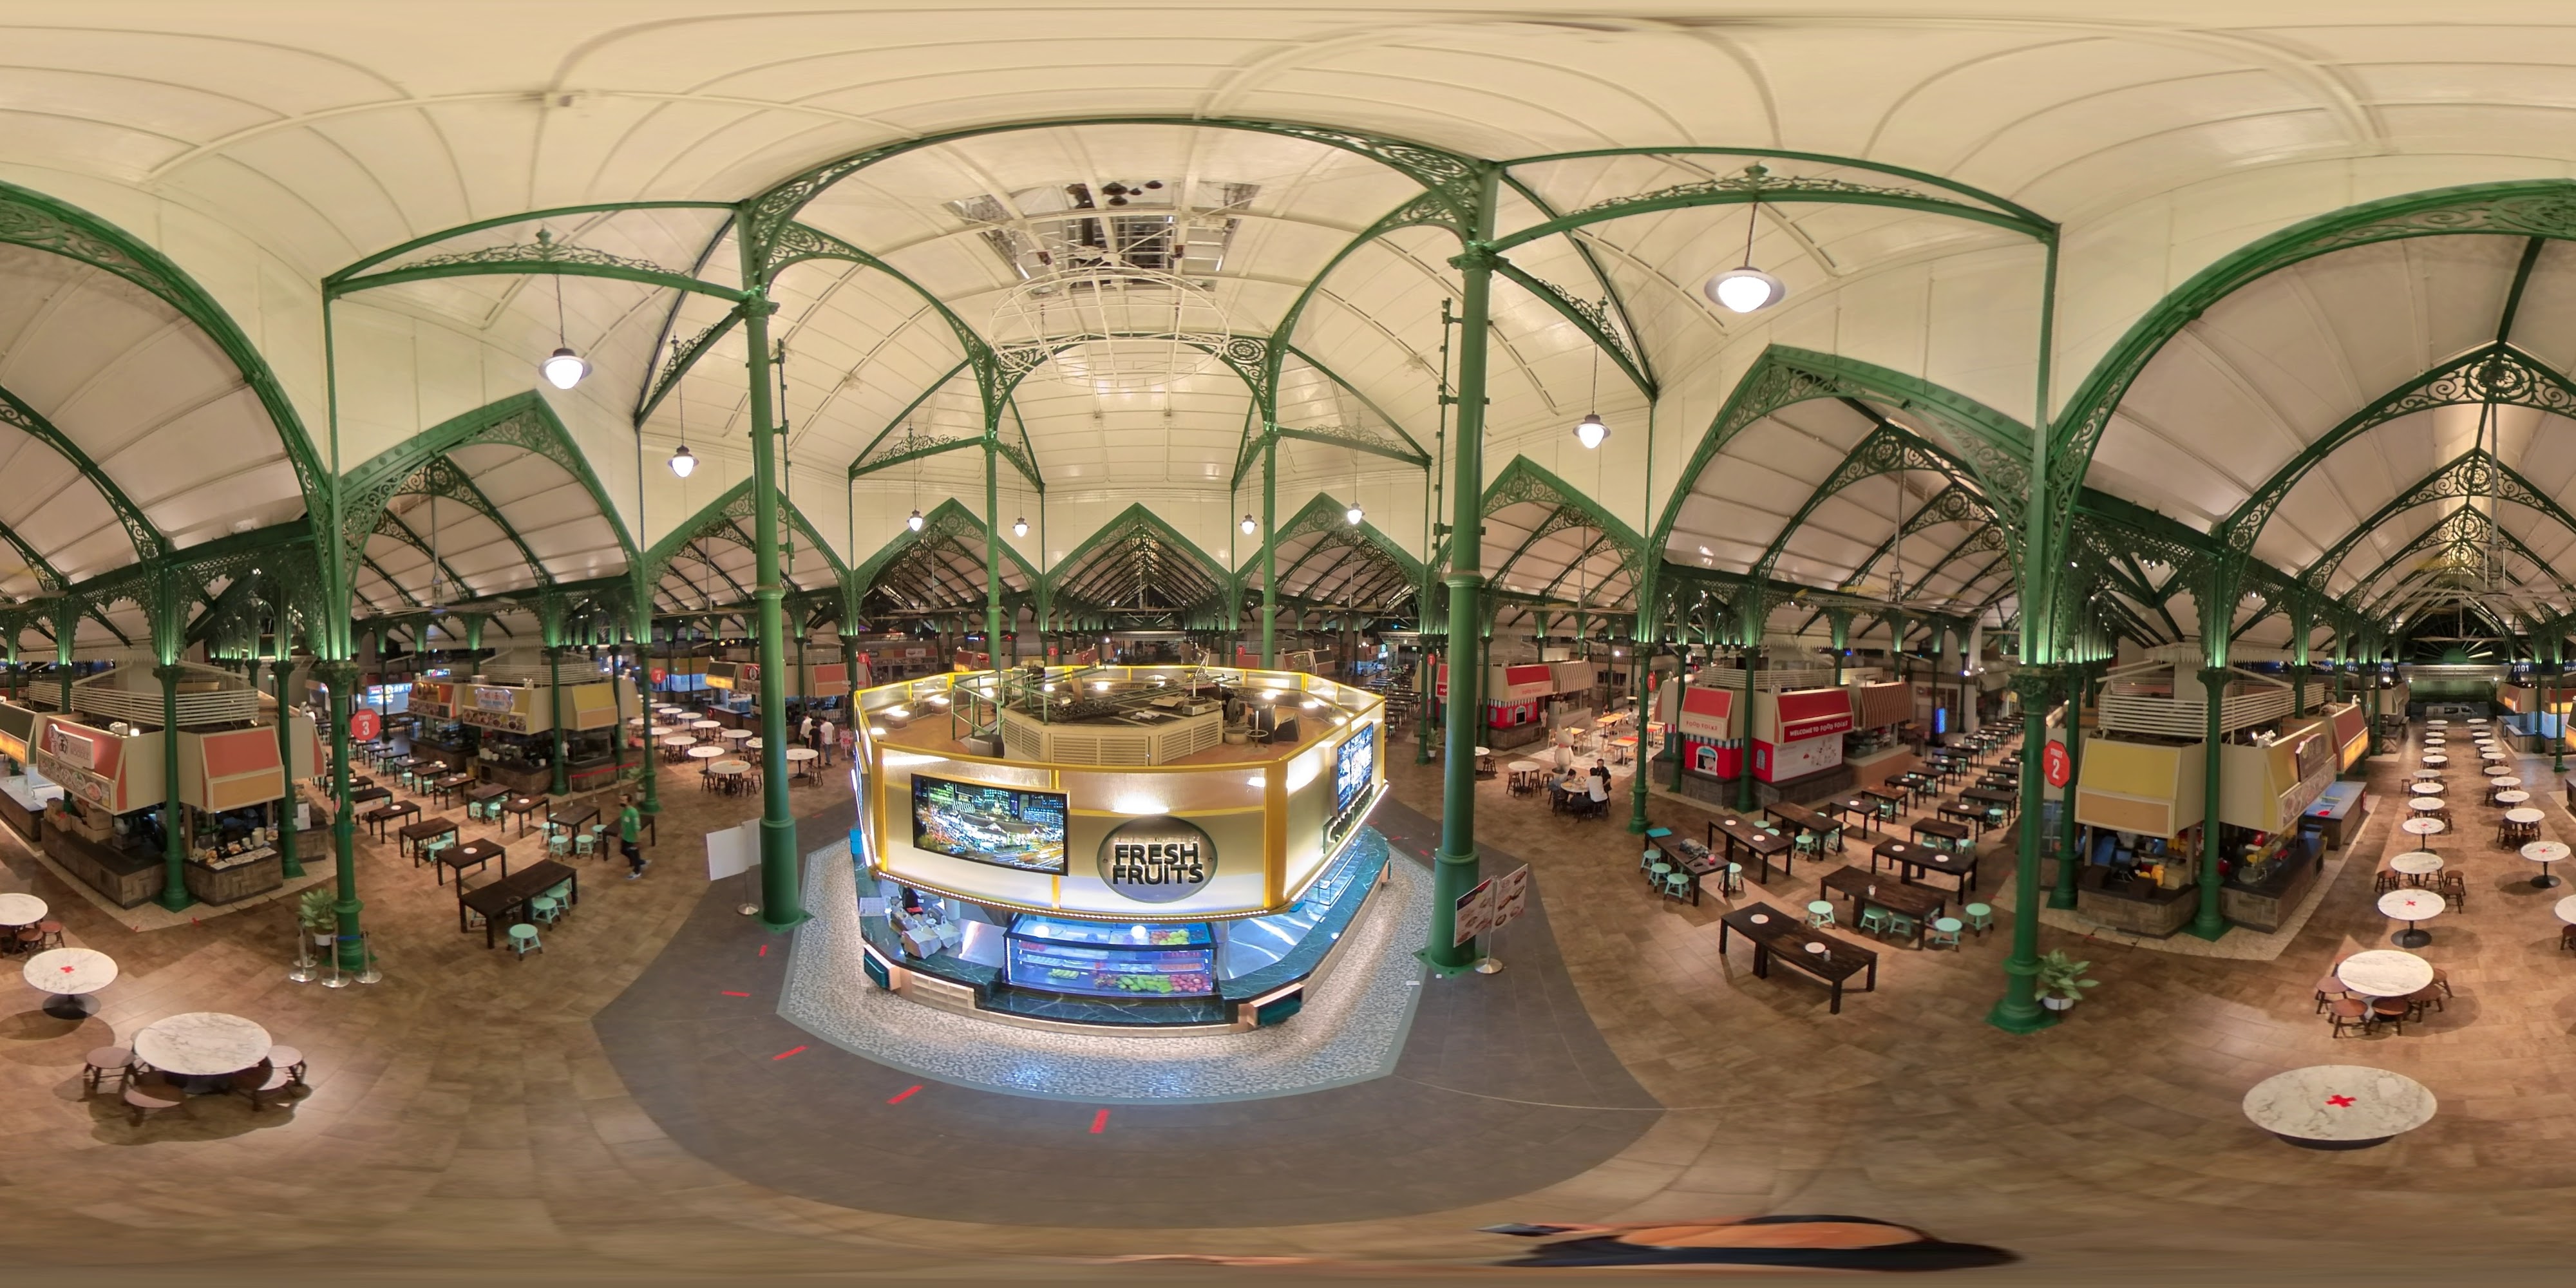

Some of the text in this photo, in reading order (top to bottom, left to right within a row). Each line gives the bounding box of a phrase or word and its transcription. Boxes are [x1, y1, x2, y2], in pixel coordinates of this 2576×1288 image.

[362, 721, 370, 735] 3
[1790, 726, 1813, 737] WELCOME
[1820, 723, 1833, 732] FOOD
[1834, 720, 1848, 728] FOLKS
[2052, 759, 2061, 780] 2
[1115, 843, 1198, 866] FRESH
[1112, 863, 1204, 885] FRUITS
